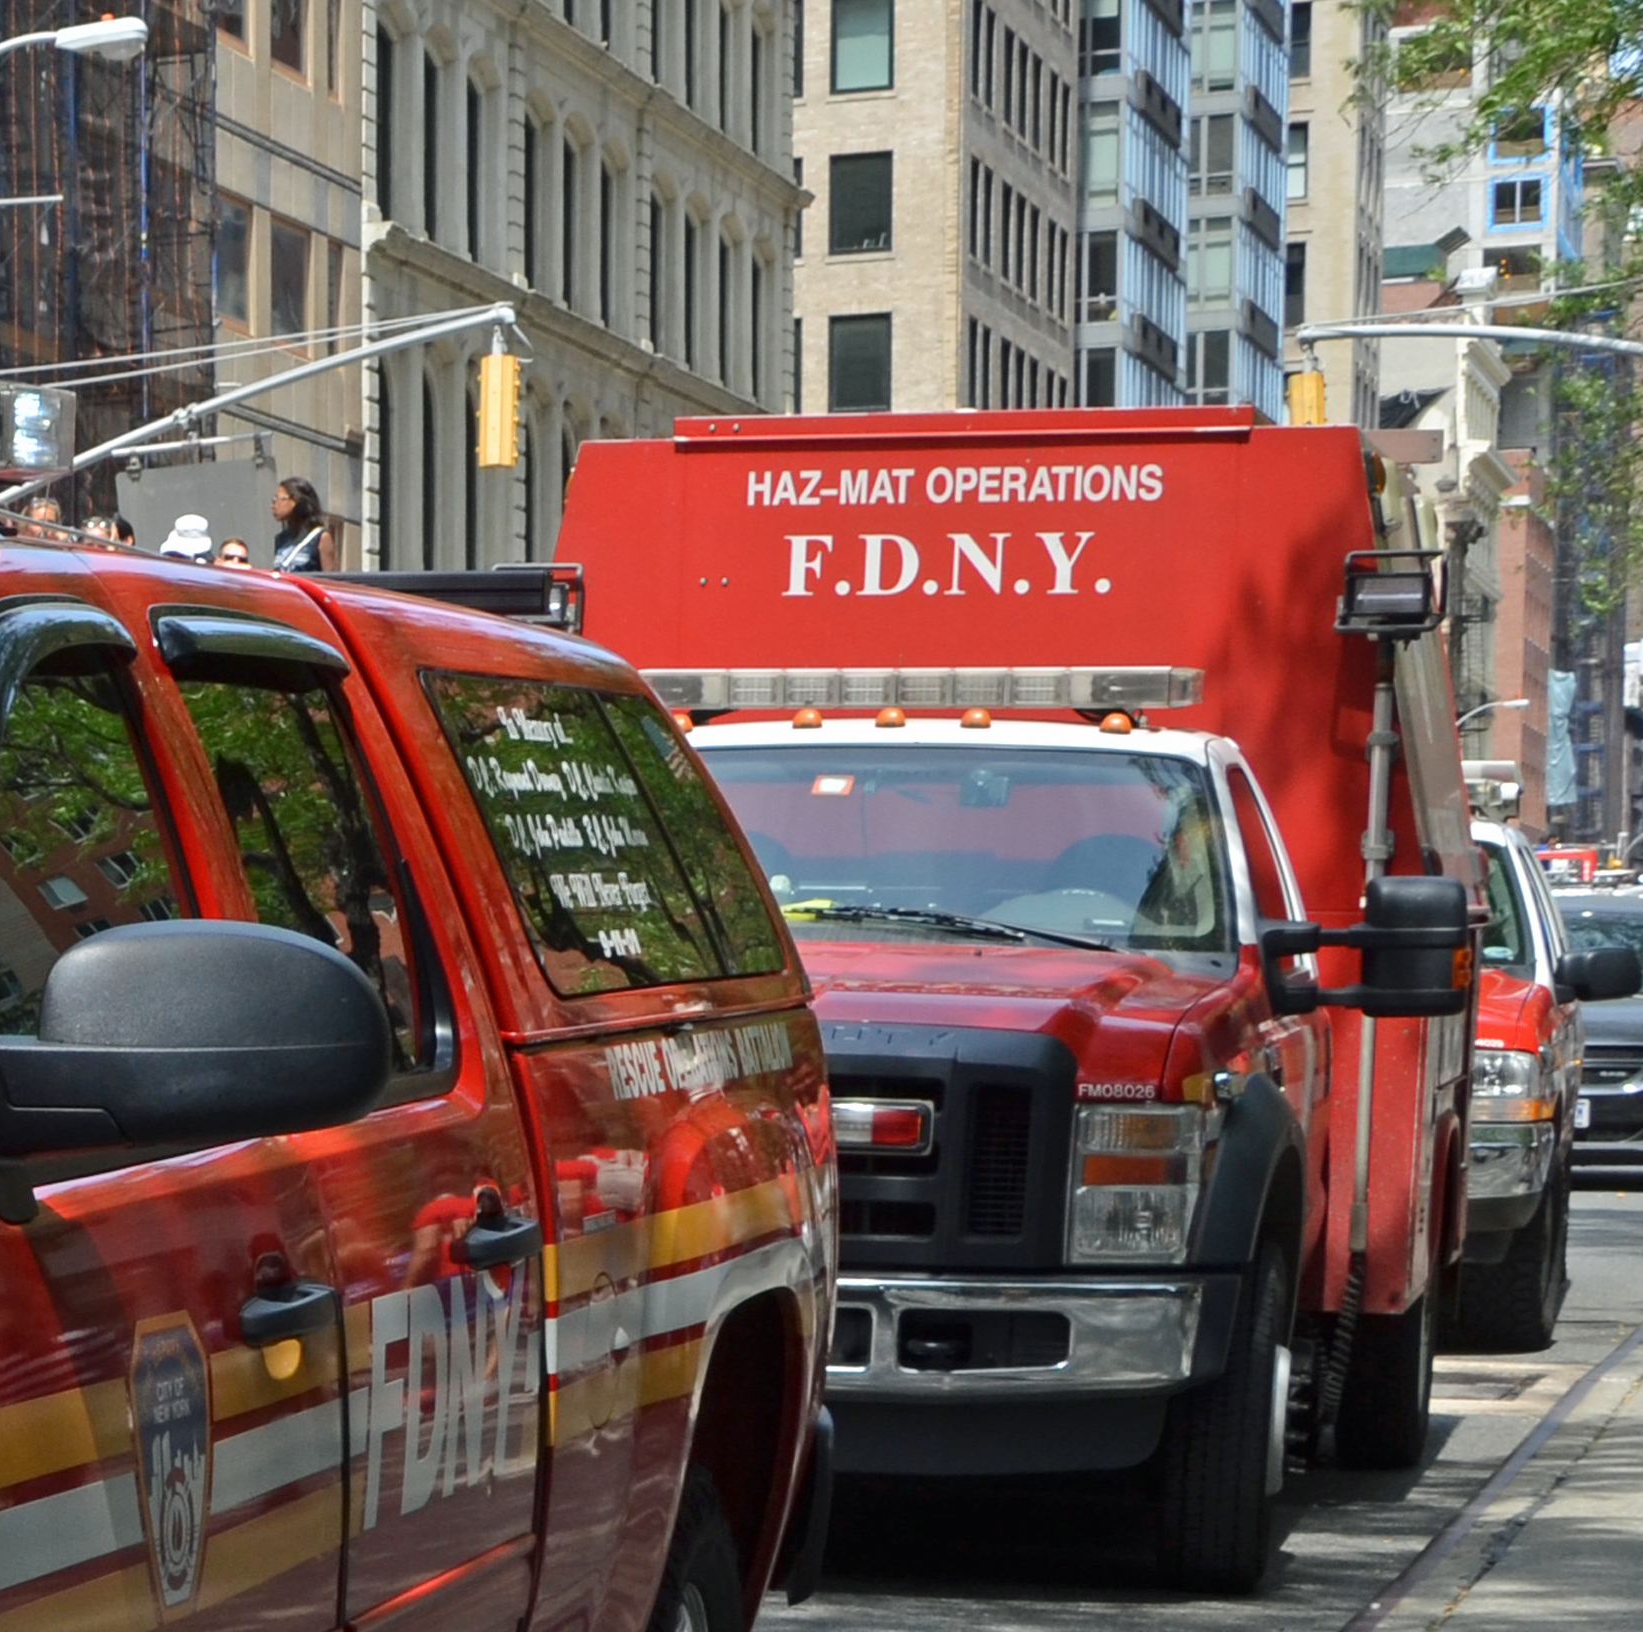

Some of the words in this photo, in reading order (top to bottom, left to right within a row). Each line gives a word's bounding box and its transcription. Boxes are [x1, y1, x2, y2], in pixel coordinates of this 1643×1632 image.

[745, 466, 914, 507] HAZ-MAT
[924, 463, 1164, 505] OPERATIONS
[783, 530, 1114, 598] F.D.N.Y.
[605, 1040, 666, 1100] RESCUE
[1078, 1083, 1156, 1100] FM08026
[153, 1403, 171, 1424] NEW
[171, 1398, 191, 1420] YORK
[156, 1381, 173, 1402] CITY
[174, 1376, 184, 1397] OF
[363, 1257, 530, 1531] FDNY
